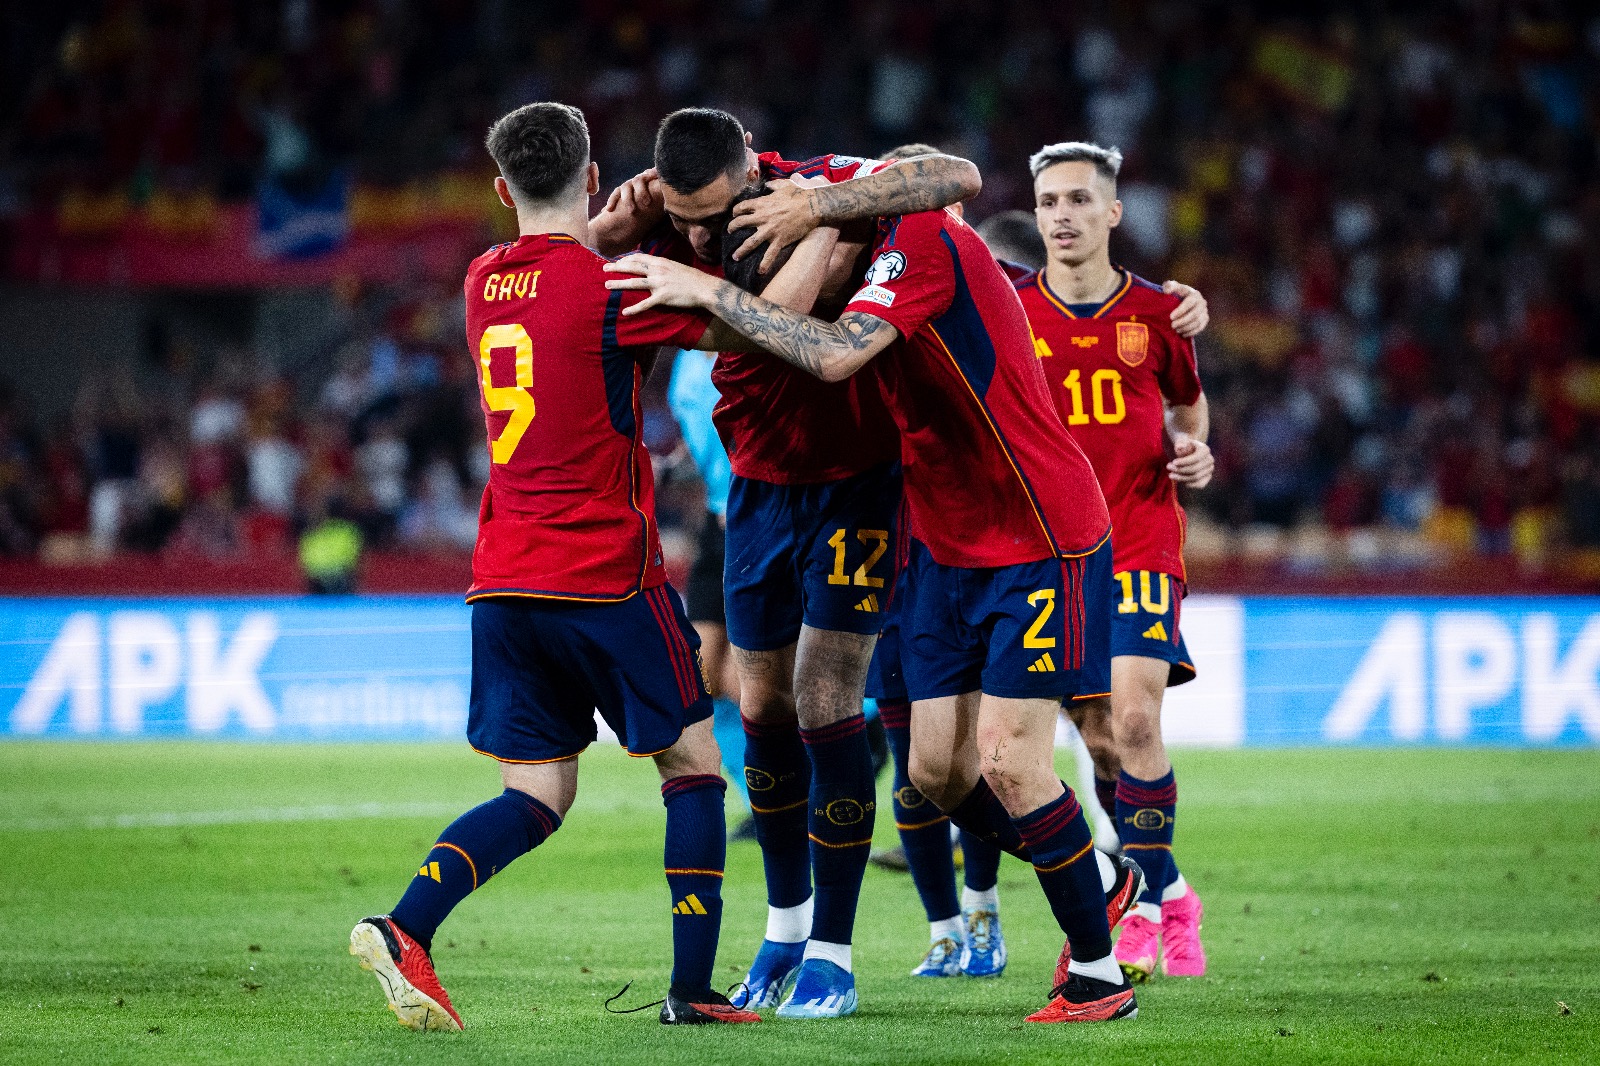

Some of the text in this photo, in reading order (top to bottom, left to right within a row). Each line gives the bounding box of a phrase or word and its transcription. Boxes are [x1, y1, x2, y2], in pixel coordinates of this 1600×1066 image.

[483, 270, 542, 302] GAVI
[479, 323, 536, 465] 9
[1062, 369, 1126, 426] 10
[827, 528, 889, 588] 12
[1023, 588, 1056, 649] 2
[1114, 570, 1171, 615] 10
[8, 610, 280, 733] APK
[1320, 611, 1600, 741] APK
